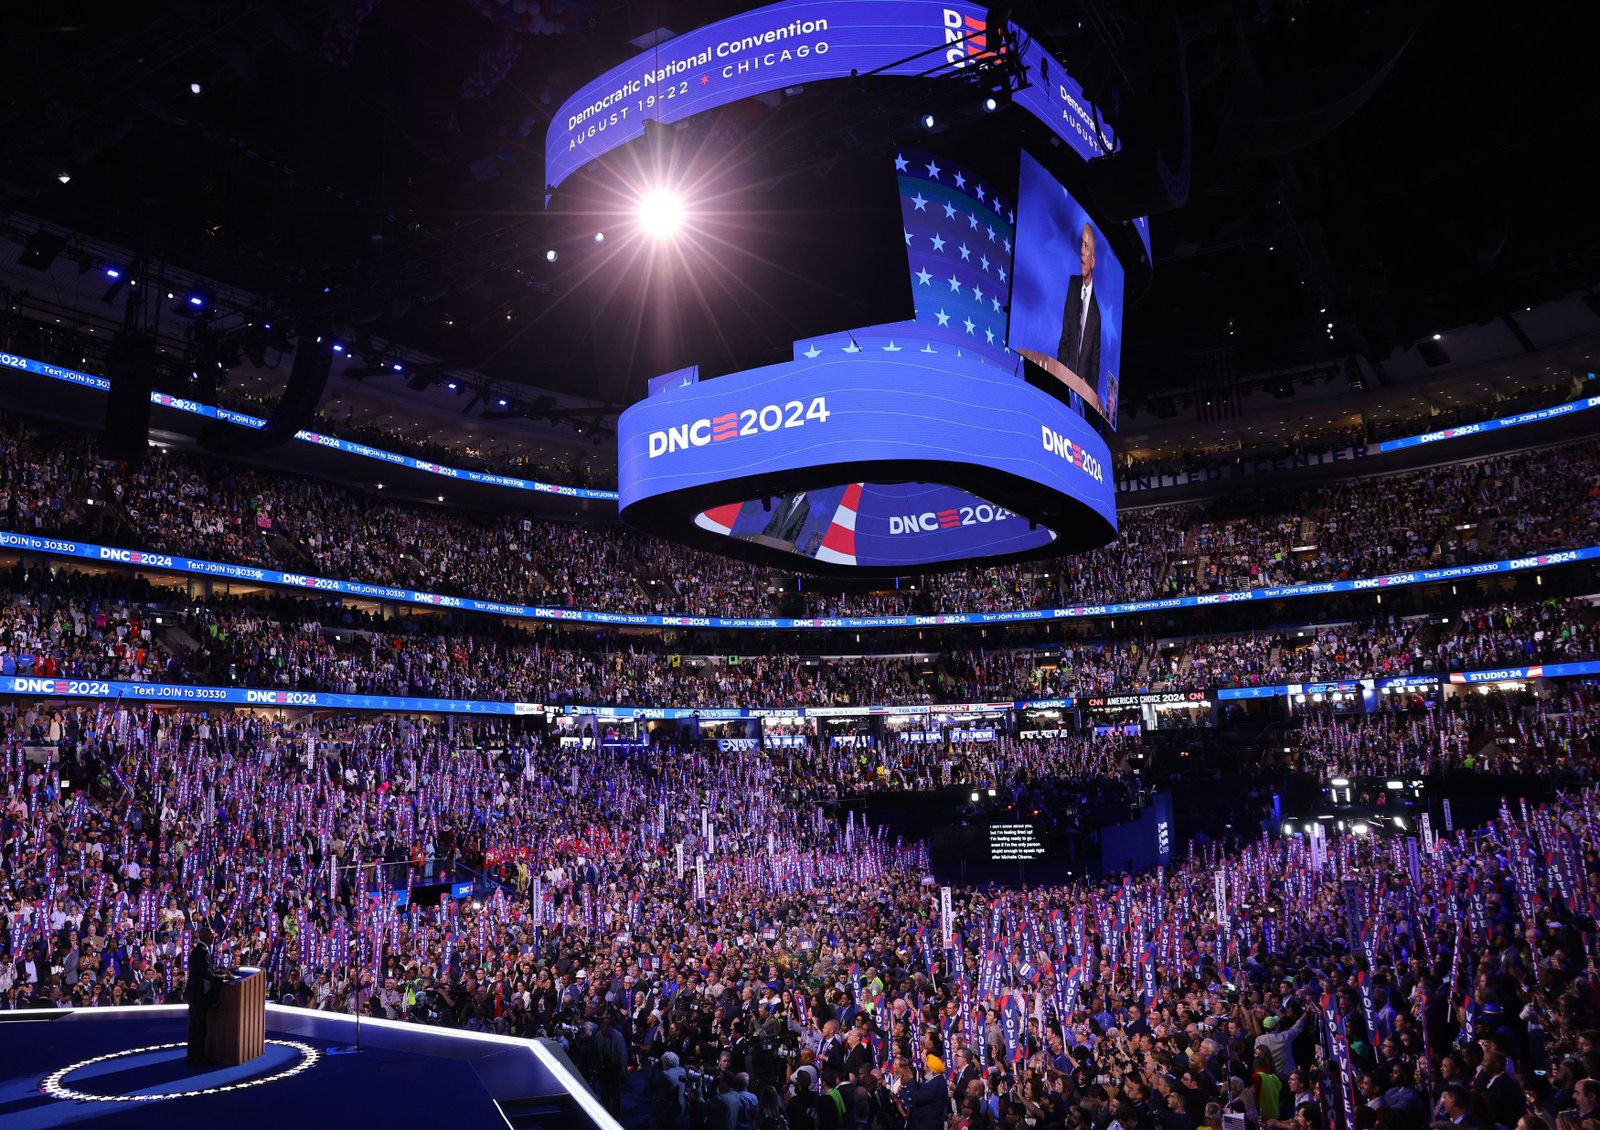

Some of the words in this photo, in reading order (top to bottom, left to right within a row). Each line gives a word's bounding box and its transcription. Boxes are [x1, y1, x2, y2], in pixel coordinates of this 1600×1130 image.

[943, 8, 966, 69] DNC
[567, 79, 642, 132] Democratic
[643, 46, 713, 89] National
[715, 17, 829, 58] Convention
[568, 107, 630, 152] AUGUST
[637, 80, 689, 113] 19-22
[721, 41, 830, 80] CHICAGO
[1062, 109, 1098, 152] AUGUST
[43, 365, 62, 377] Text
[63, 371, 85, 382] JOIN
[87, 376, 95, 385] to
[170, 400, 197, 411] 2024
[216, 410, 231, 420] Text
[231, 413, 249, 425] JOIN
[249, 419, 257, 427] to
[648, 418, 711, 459] DNC
[739, 396, 831, 437] 2024
[1421, 431, 1445, 443] DNC
[1452, 424, 1480, 437] 2024
[1500, 417, 1516, 426] Text
[1517, 413, 1538, 423] JOIN
[1538, 410, 1548, 419] to
[318, 435, 340, 447] 2024
[1041, 424, 1074, 459] DNC
[1081, 448, 1103, 484] 2024
[416, 460, 433, 471] DNC
[438, 465, 458, 477] 2024
[1116, 469, 1221, 493] UNITED
[1254, 444, 1368, 472] CENTER
[534, 482, 553, 492] DNC
[557, 486, 577, 496] 2024
[889, 512, 939, 535] DNC
[3, 535, 29, 546] JOIN
[31, 538, 42, 547] to
[43, 540, 76, 552] 30330
[100, 547, 131, 561] DNC
[141, 553, 172, 567] 2024
[186, 560, 204, 570] Text
[205, 564, 225, 573] JOIN
[226, 566, 235, 574] to
[283, 573, 307, 585] DNC
[314, 578, 339, 589] 2024
[346, 583, 361, 591] Text
[361, 585, 378, 596] JOIN
[378, 587, 385, 595] to
[386, 588, 406, 598] 30330
[414, 592, 434, 602] DNC
[440, 596, 460, 607] 2024
[486, 603, 500, 611] JOIN
[535, 608, 555, 618] DNC
[561, 610, 582, 620] 2024
[662, 617, 682, 625] DNC
[689, 618, 710, 626] 2024
[793, 619, 814, 627] DNC
[820, 619, 841, 627] 2024
[915, 616, 936, 625] DNC
[943, 615, 966, 624] 2024
[1054, 608, 1076, 617] DNC
[1083, 606, 1106, 615] 2024
[1197, 595, 1220, 604] DNC
[1227, 591, 1253, 601] 2024
[1281, 587, 1298, 596] JOIN
[1354, 578, 1380, 589] DNC
[1387, 574, 1415, 584] 2024
[1423, 571, 1440, 579] Text
[1441, 568, 1461, 577] JOIN
[1461, 567, 1471, 575] to
[1471, 563, 1498, 573] 30330
[1510, 558, 1539, 570] DNC
[1547, 551, 1577, 565] 2024
[1408, 677, 1439, 686] CHICAGO
[1469, 671, 1508, 681] STUDIO
[1509, 669, 1522, 678] 24
[13, 678, 55, 693] DNC
[68, 680, 110, 695] 2024
[132, 685, 155, 696] Text
[157, 686, 182, 697] JOIN
[184, 688, 194, 697] to
[196, 688, 227, 700] 30330
[247, 690, 277, 703] DNC
[286, 693, 317, 704] 2024
[1032, 701, 1066, 709] MSNBC
[1088, 698, 1104, 706] CNN
[1162, 693, 1186, 702] 2024
[1189, 692, 1205, 700] CNN
[1423, 817, 1432, 848] OHIO
[1561, 847, 1572, 877] VOTE
[112, 901, 120, 924] VOTE
[1022, 932, 1031, 962] VOTE
[1055, 918, 1064, 946] VOTE
[1074, 925, 1082, 956] VOTE
[1102, 919, 1111, 945] VOTE
[922, 935, 932, 965] VOTE
[852, 973, 860, 1005] VOTE
[1019, 964, 1040, 984] USA
[1144, 963, 1154, 997] VOTE
[1064, 979, 1077, 1012] VOTE
[1362, 984, 1375, 1031] VOTE
[1005, 1009, 1015, 1049] VOTE
[1327, 1010, 1339, 1055] VOTE
[1464, 1009, 1473, 1042] VOT
[943, 1029, 951, 1067] VOTE
[1340, 1055, 1352, 1114] VOTE
